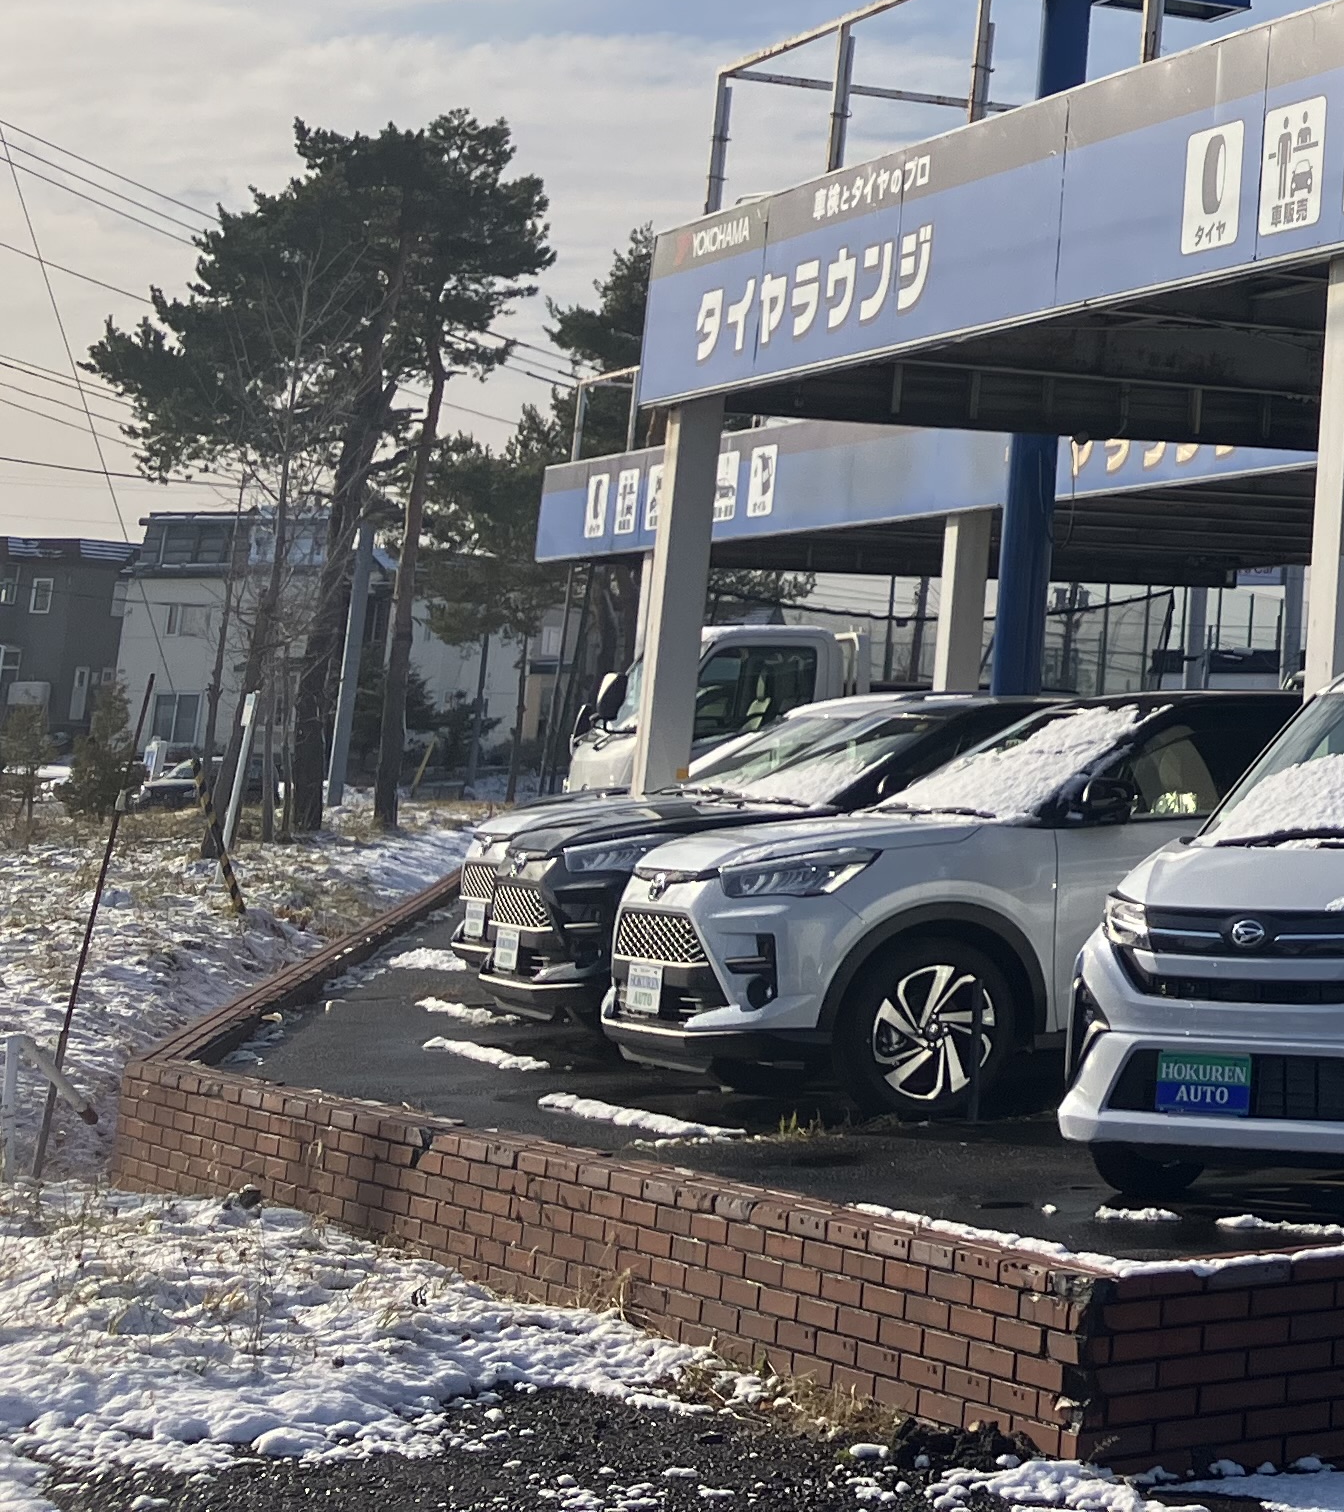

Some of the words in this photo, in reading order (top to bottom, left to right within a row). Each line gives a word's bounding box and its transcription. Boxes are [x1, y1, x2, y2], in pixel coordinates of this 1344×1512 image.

[812, 154, 931, 221] 車検とタイヤのプロ
[1270, 197, 1310, 228] 車販売
[691, 216, 751, 259] YOKOHAMA
[1194, 219, 1227, 248] タイヤ
[695, 223, 935, 362] タイヤラウンジ
[1161, 1062, 1247, 1083] HOKUREN
[1175, 1084, 1229, 1104] AUTO
